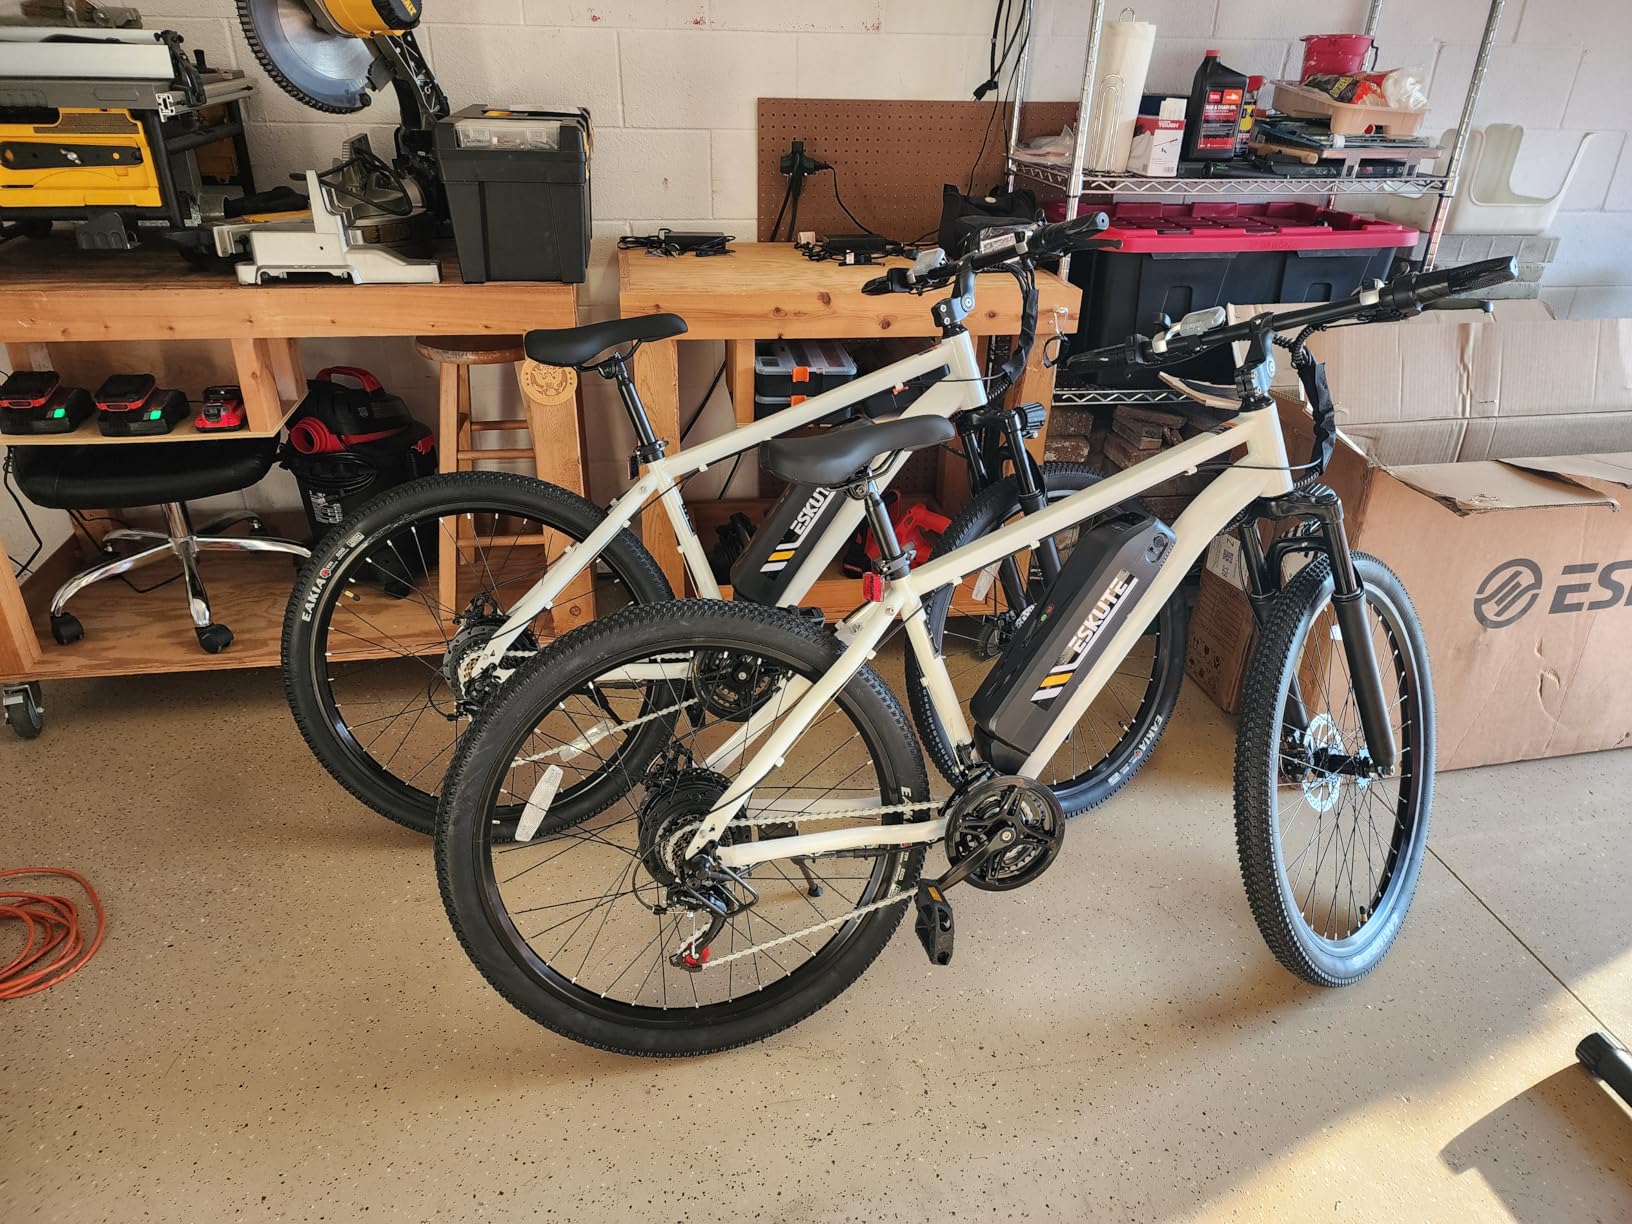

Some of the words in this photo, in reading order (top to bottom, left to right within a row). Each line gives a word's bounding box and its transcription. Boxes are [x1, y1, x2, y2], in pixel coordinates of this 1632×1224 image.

[790, 487, 830, 536] ESKUT
[301, 578, 327, 623] EAKIA
[1548, 559, 1632, 615] ES
[1067, 577, 1129, 654] ESKUTE
[1138, 714, 1164, 752] EAKIA
